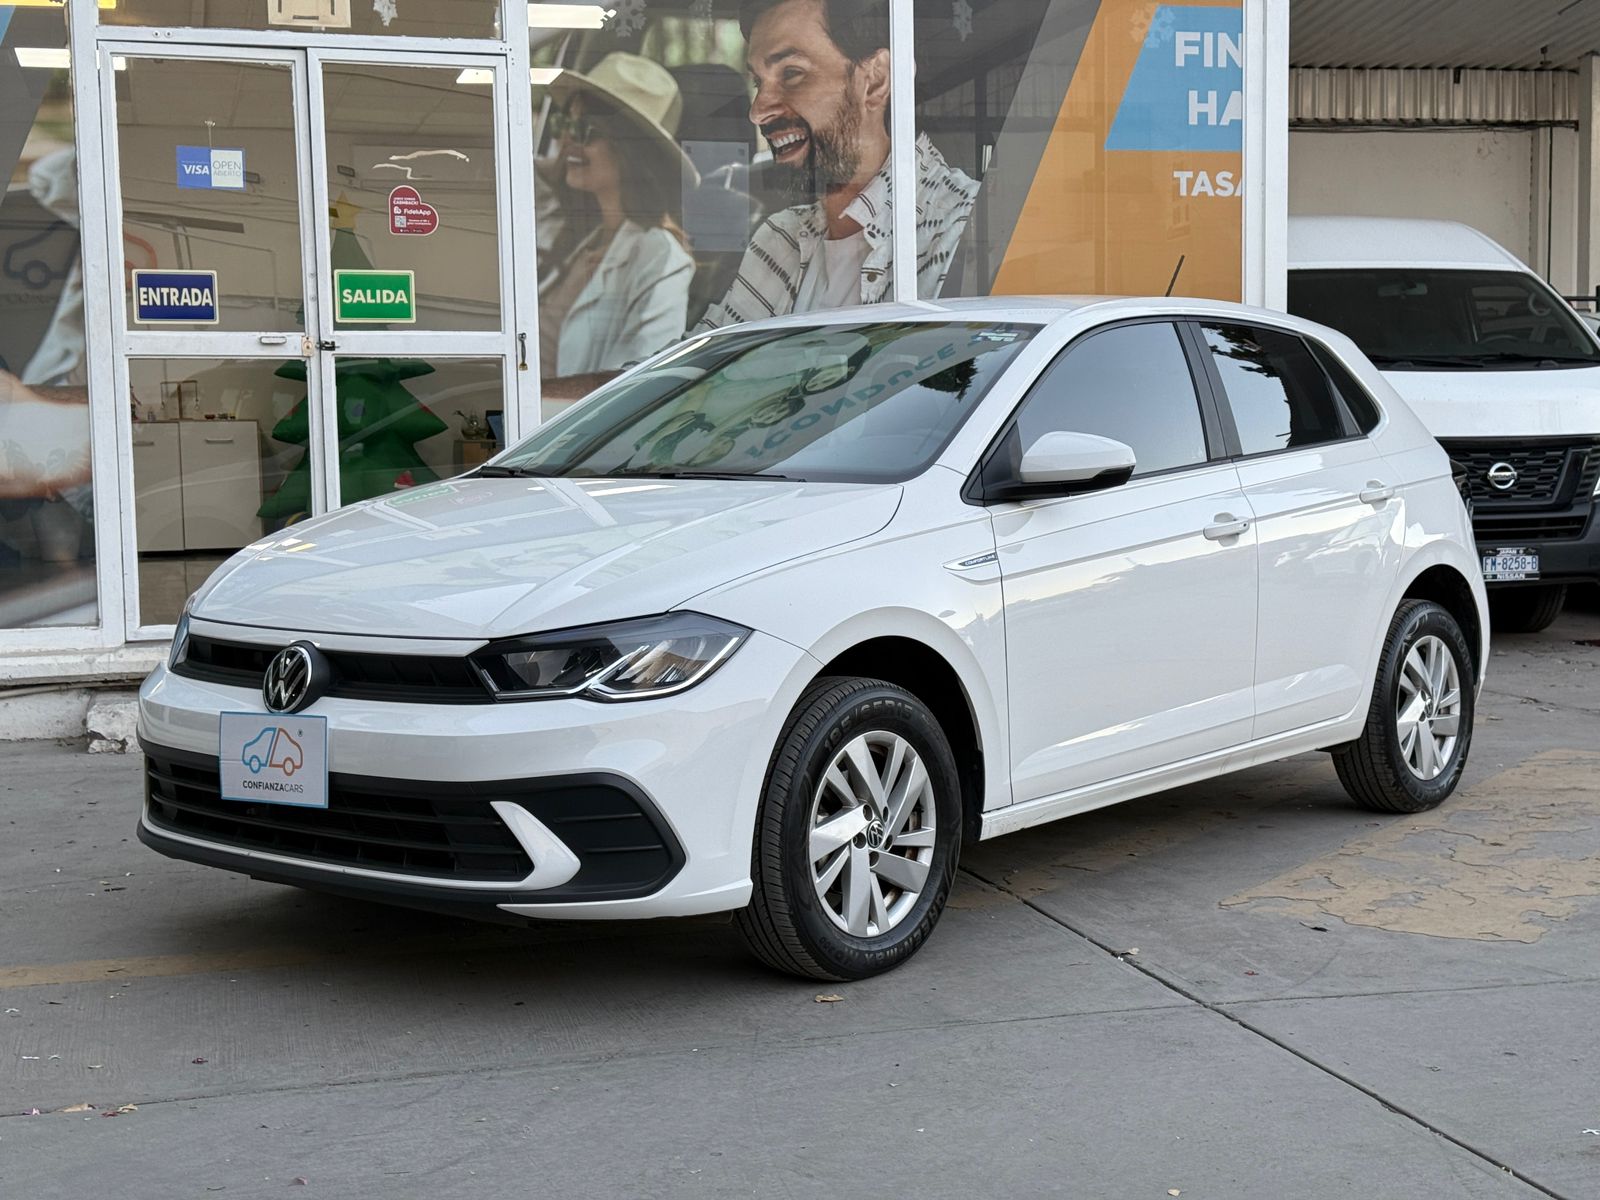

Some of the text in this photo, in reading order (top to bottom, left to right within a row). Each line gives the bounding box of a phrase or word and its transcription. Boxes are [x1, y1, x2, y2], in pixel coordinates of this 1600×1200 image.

[1175, 32, 1243, 68] FIN
[182, 164, 210, 175] VISA
[212, 160, 241, 170] OPEN
[1173, 170, 1243, 198] TAS
[139, 287, 214, 307] ENTRADA
[342, 289, 408, 305] SALIDA
[242, 780, 304, 794] CONFIANZACARS
